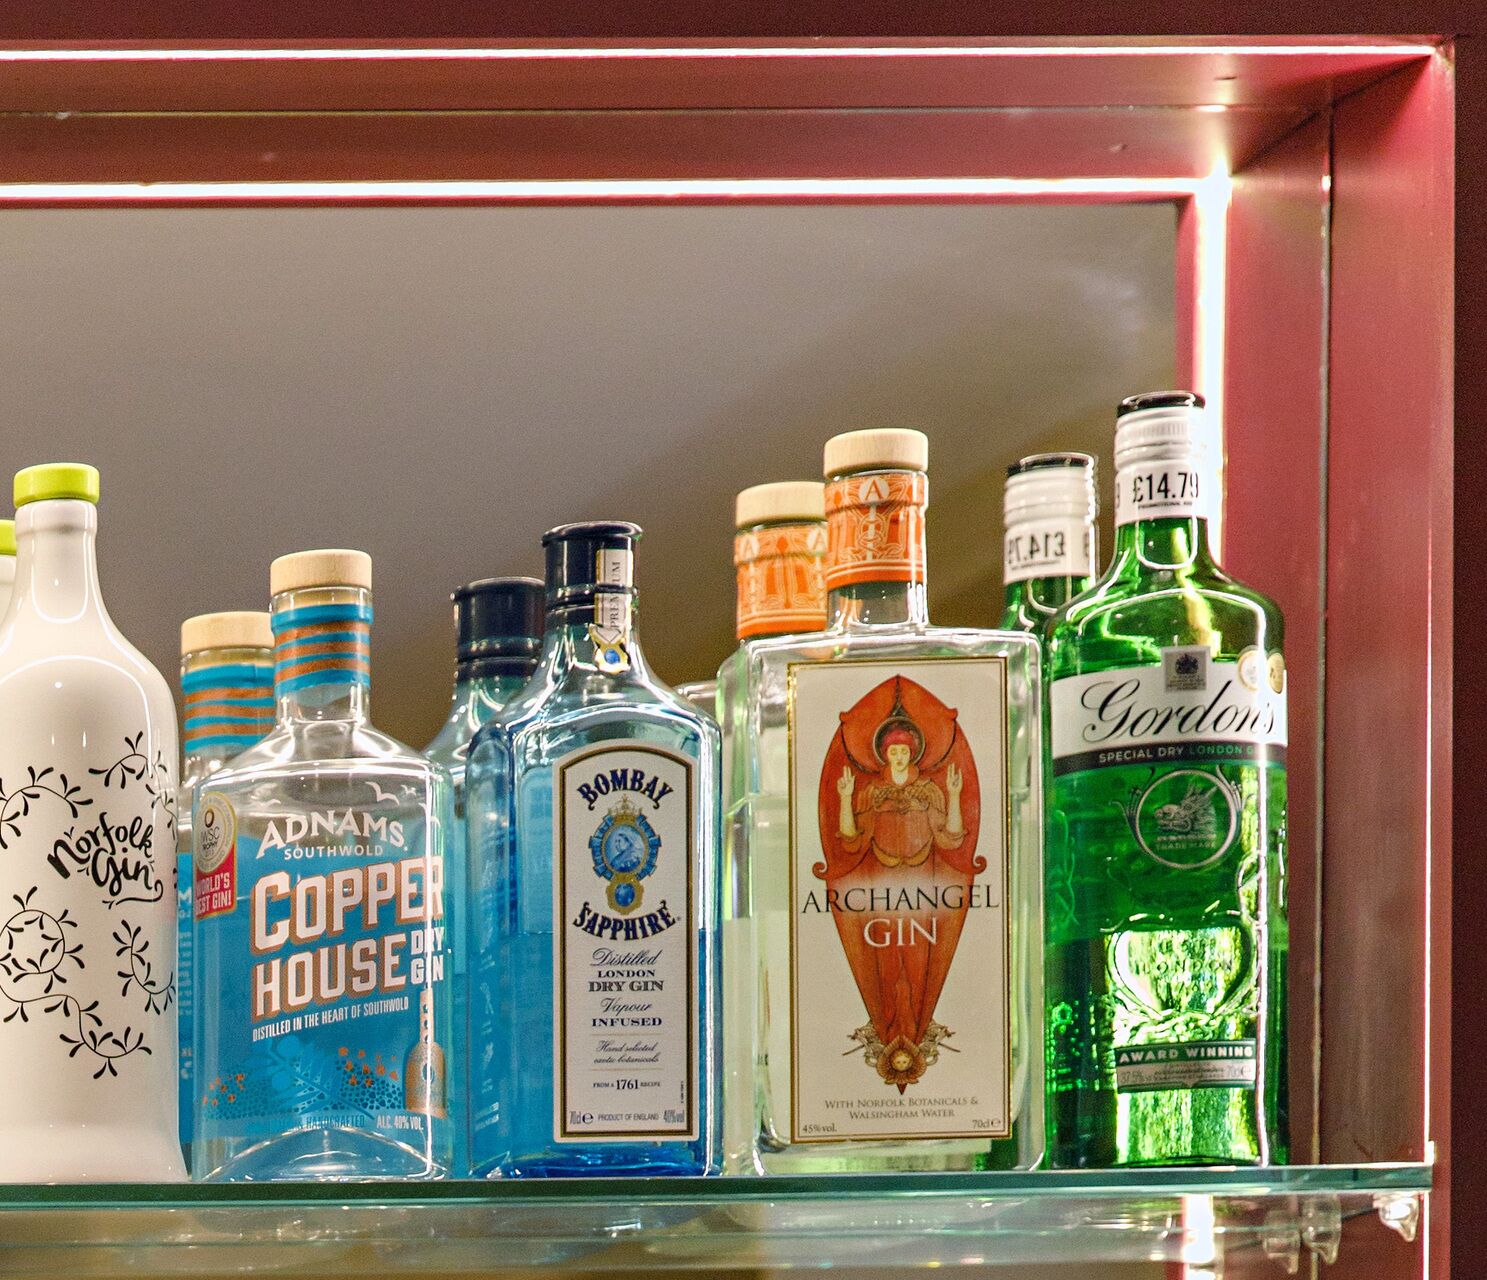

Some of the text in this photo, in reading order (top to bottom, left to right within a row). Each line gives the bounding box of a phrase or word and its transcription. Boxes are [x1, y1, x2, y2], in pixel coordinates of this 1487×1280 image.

[1132, 471, 1199, 504] £14.79
[1080, 677, 1275, 746] Gordon's
[576, 766, 674, 812] BOMBAY
[46, 812, 152, 879] Norfolk
[255, 807, 404, 859] ADNAMS
[284, 844, 384, 860] SOUTHWOLD
[90, 846, 155, 897] Gin
[251, 856, 444, 957] COPPER
[800, 884, 1000, 914] ARCHANGEL
[572, 898, 678, 943] SAPPHIRE
[863, 916, 938, 948] GIN
[252, 932, 407, 1022] HOUSE
[588, 980, 664, 992] DRY GIN
[598, 970, 656, 978] LONDON
[592, 1018, 663, 1027] INFUSED
[1119, 1046, 1252, 1064] AWARD WINNING
[848, 1108, 955, 1120] WALSINGHAM WATER
